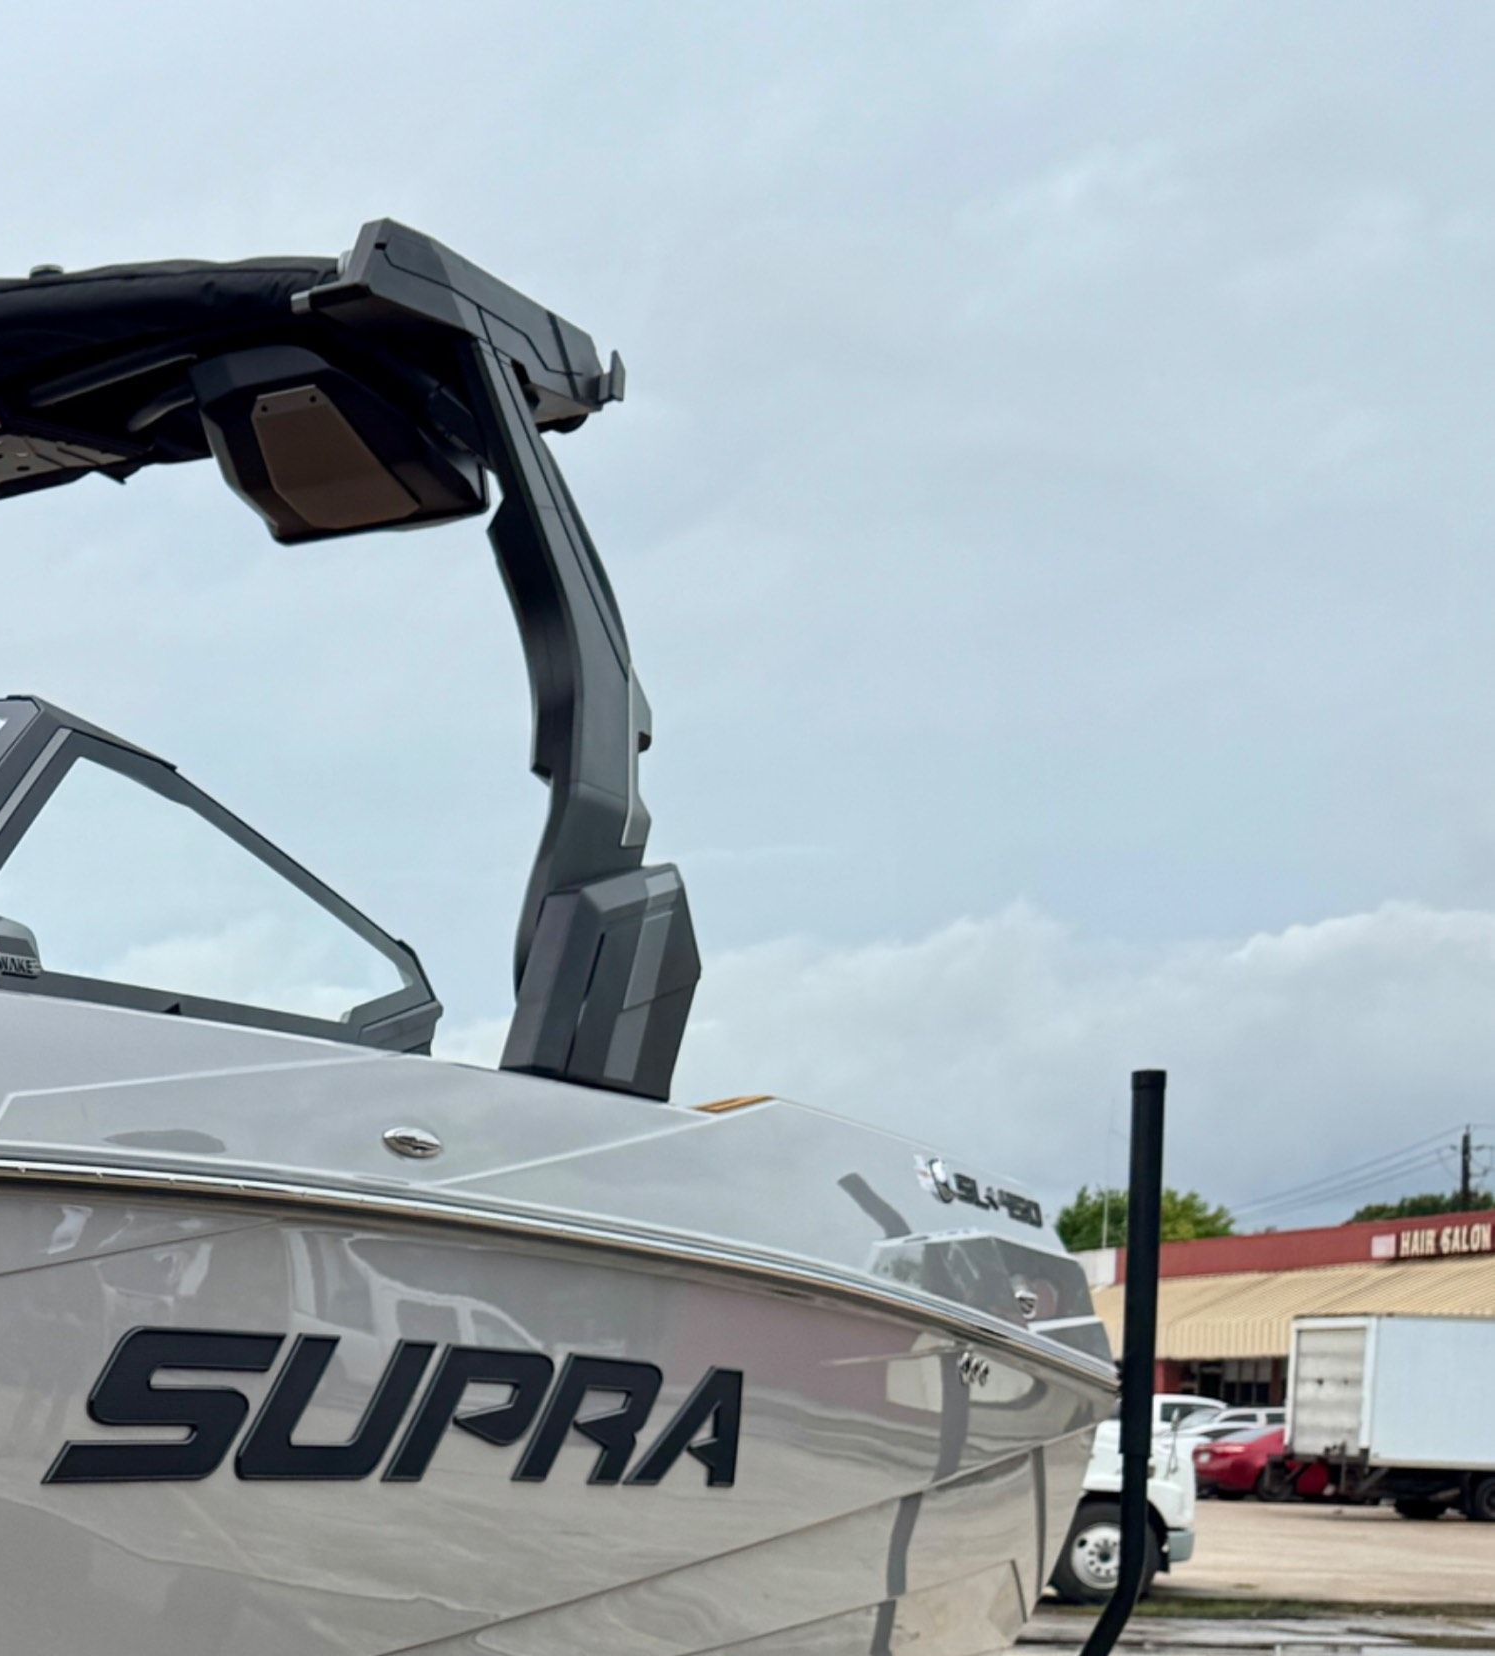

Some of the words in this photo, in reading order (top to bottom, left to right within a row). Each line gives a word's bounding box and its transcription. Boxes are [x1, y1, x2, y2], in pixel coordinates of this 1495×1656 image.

[1399, 1228, 1437, 1258] HAIR
[1440, 1222, 1492, 1255] SALON
[40, 1325, 744, 1487] SUPRA
